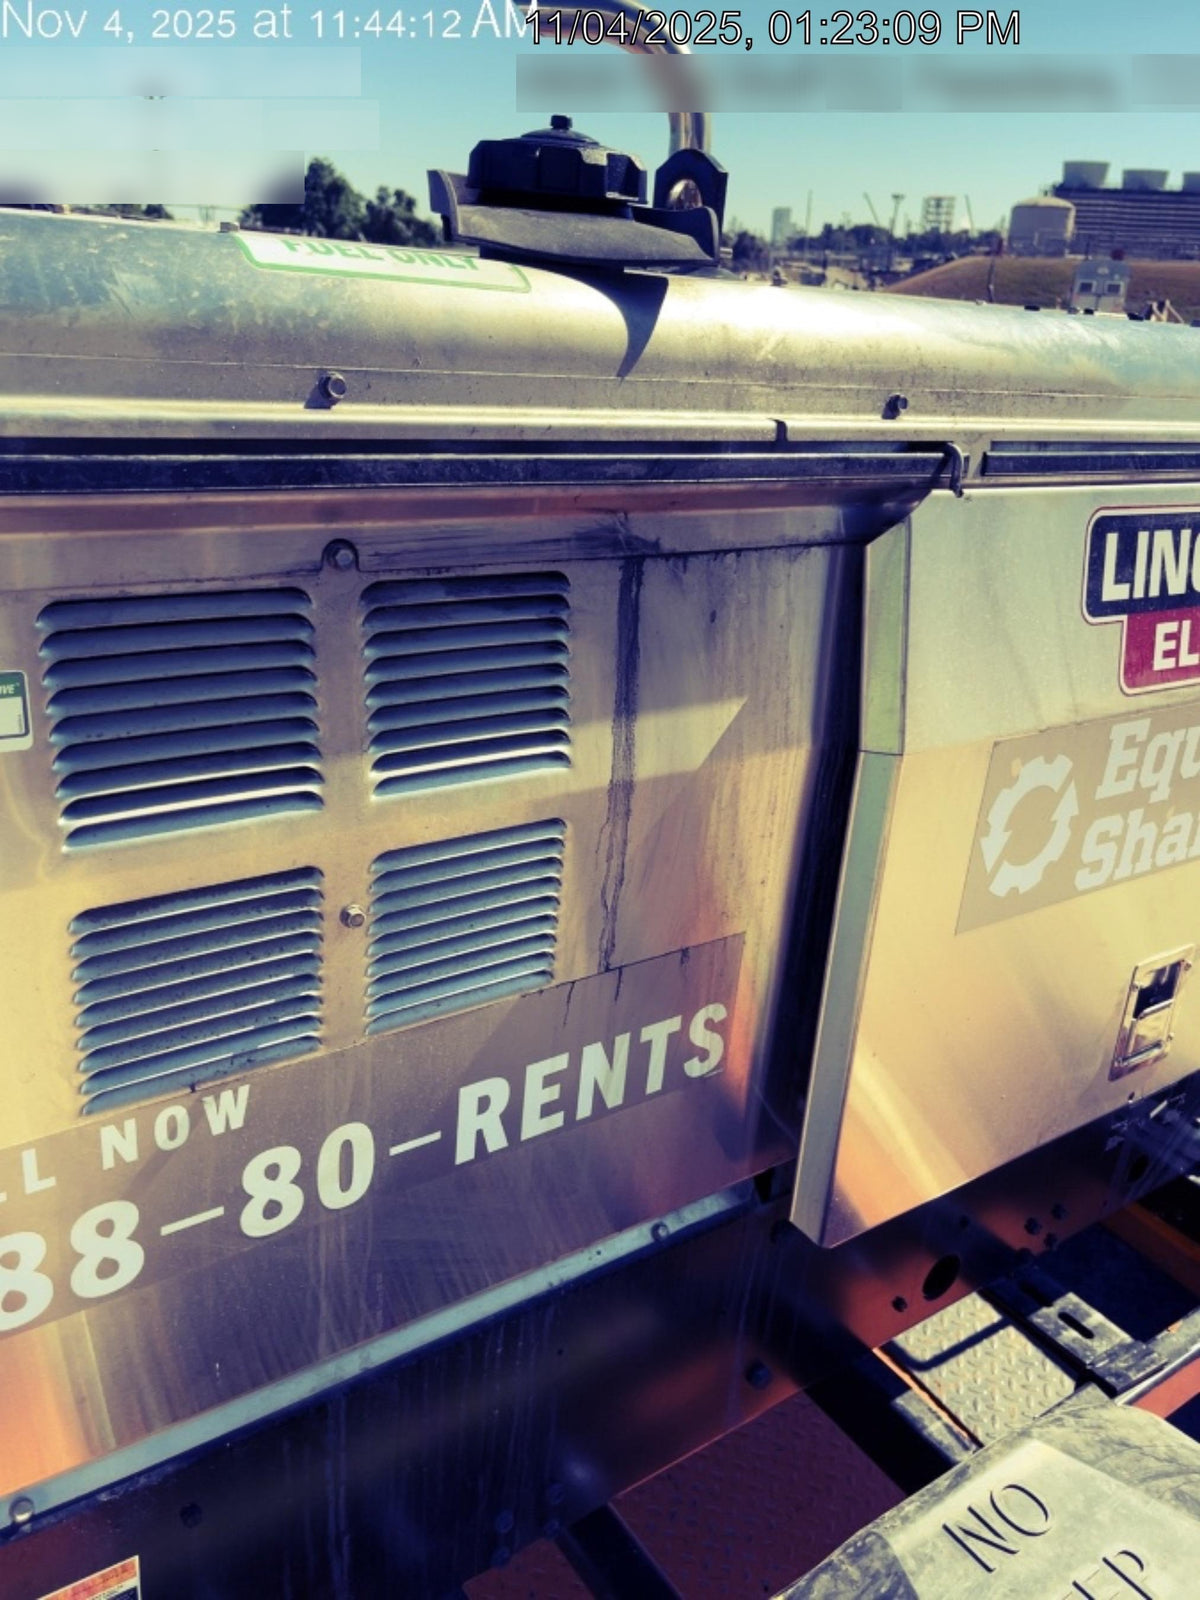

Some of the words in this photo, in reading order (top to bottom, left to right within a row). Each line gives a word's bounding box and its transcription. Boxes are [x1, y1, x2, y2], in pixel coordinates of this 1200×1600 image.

[281, 238, 384, 261] FUEL
[100, 1084, 250, 1171] NOW
[942, 1484, 1053, 1573] NO
